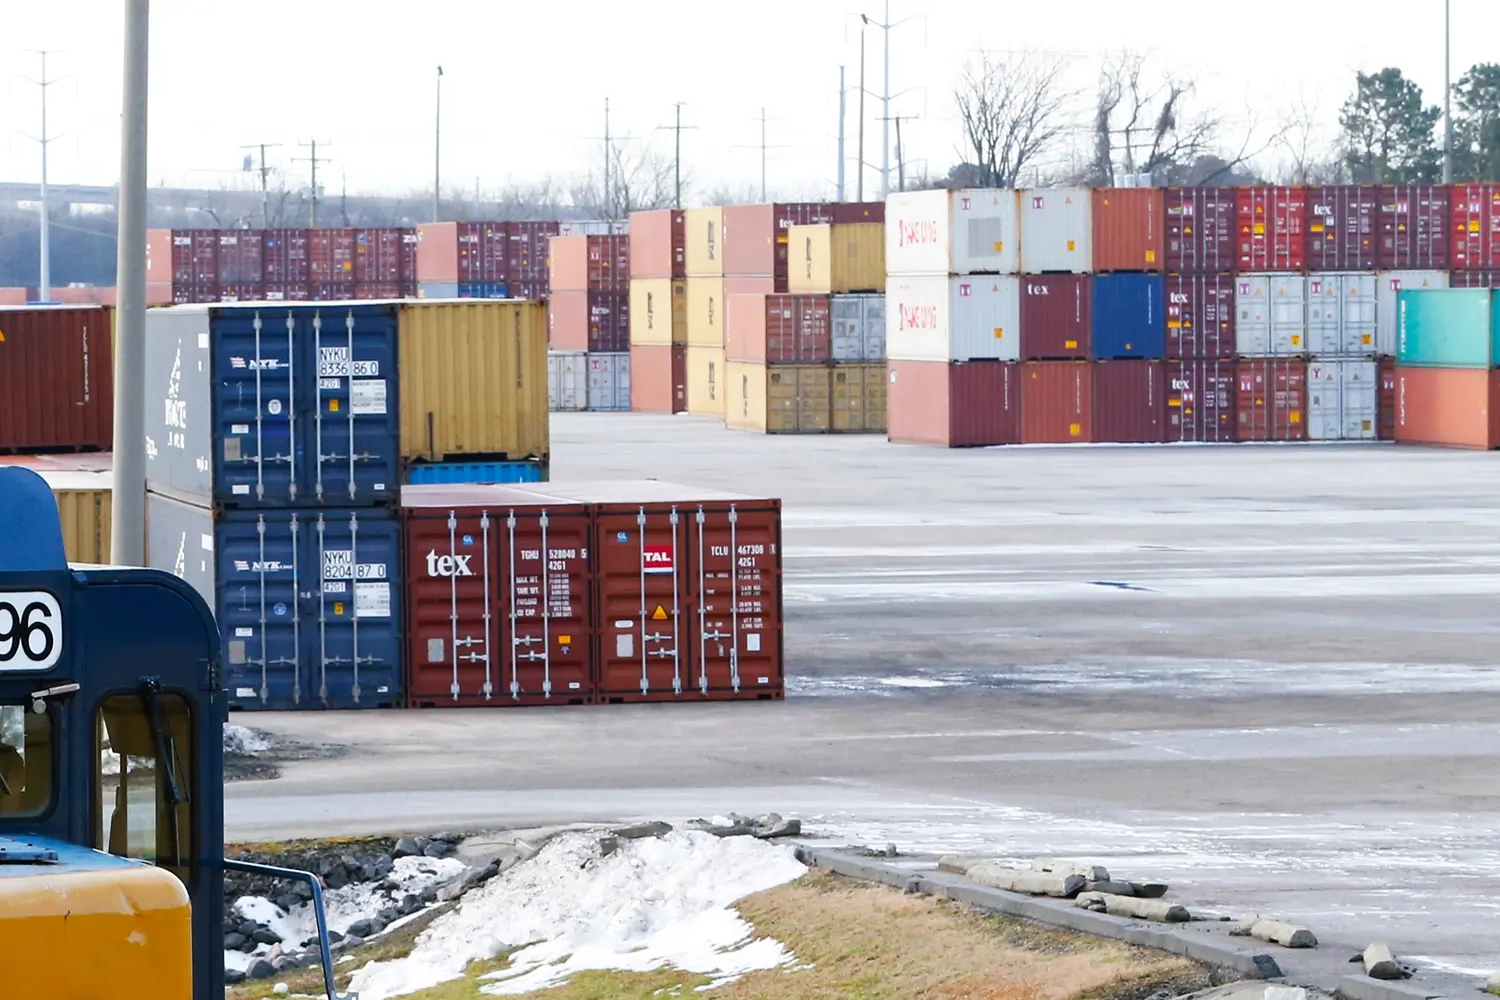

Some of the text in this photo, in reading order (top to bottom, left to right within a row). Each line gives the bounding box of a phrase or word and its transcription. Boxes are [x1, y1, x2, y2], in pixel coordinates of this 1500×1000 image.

[1027, 283, 1049, 295] tex
[320, 349, 349, 361] NYKU
[370, 362, 378, 374] 0
[520, 550, 539, 560] TGHU
[580, 549, 587, 558] 5
[643, 552, 671, 562] TAL
[711, 546, 729, 556] TCLU
[325, 552, 352, 564] NYKU
[426, 549, 473, 577] tex
[738, 557, 756, 567] 42G1
[377, 565, 385, 577] 0
[548, 560, 566, 570] 42G1
